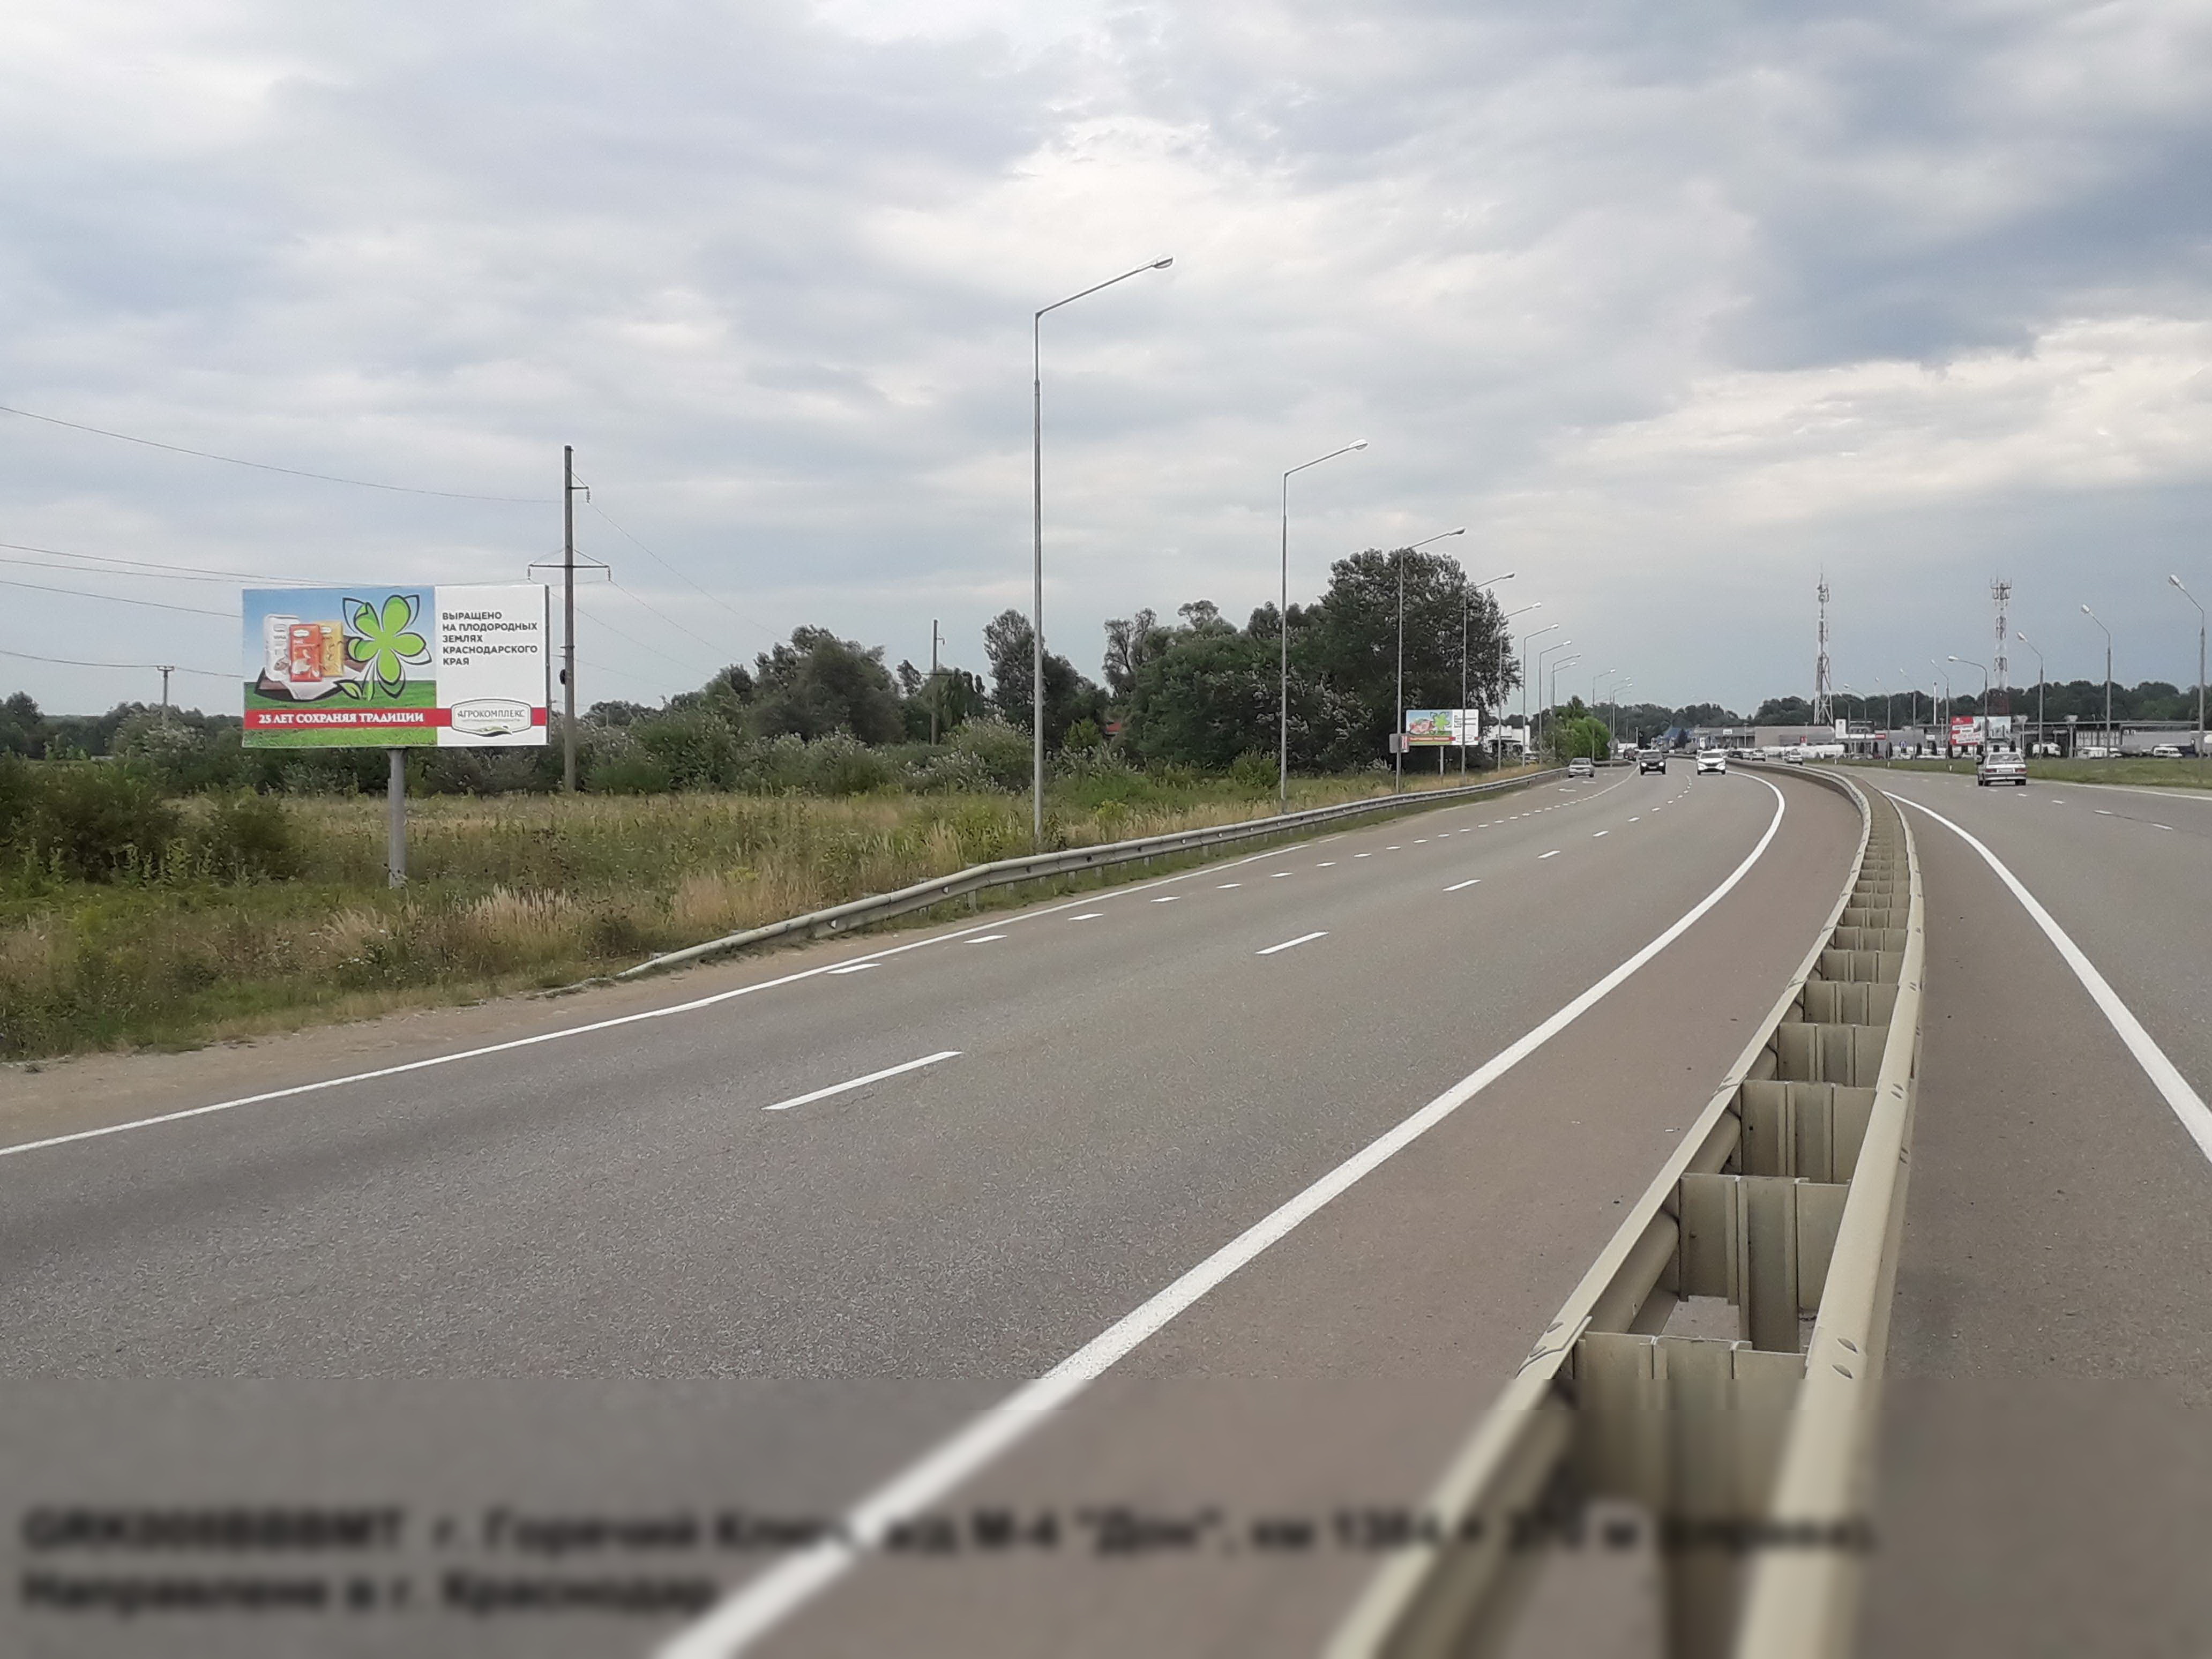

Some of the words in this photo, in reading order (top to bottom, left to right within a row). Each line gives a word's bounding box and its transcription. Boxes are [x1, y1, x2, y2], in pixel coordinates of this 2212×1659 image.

[442, 611, 502, 621] ВЫРАЩЕНО
[442, 623, 457, 631] НА
[459, 622, 537, 632] ПЛОДОРОДНЫХ
[442, 634, 483, 642] ЗЕМЛЯХ
[443, 645, 537, 655] КРАСНОДАРСКОГО
[443, 657, 469, 666] КРАЯ
[258, 714, 271, 723] 25
[273, 714, 294, 723] ЛЕТ
[296, 713, 356, 723] СОХРАНЯЯ
[359, 712, 424, 723] ТРАДИЦИИ
[457, 709, 526, 718] АГРОКОМПЛЕКС
